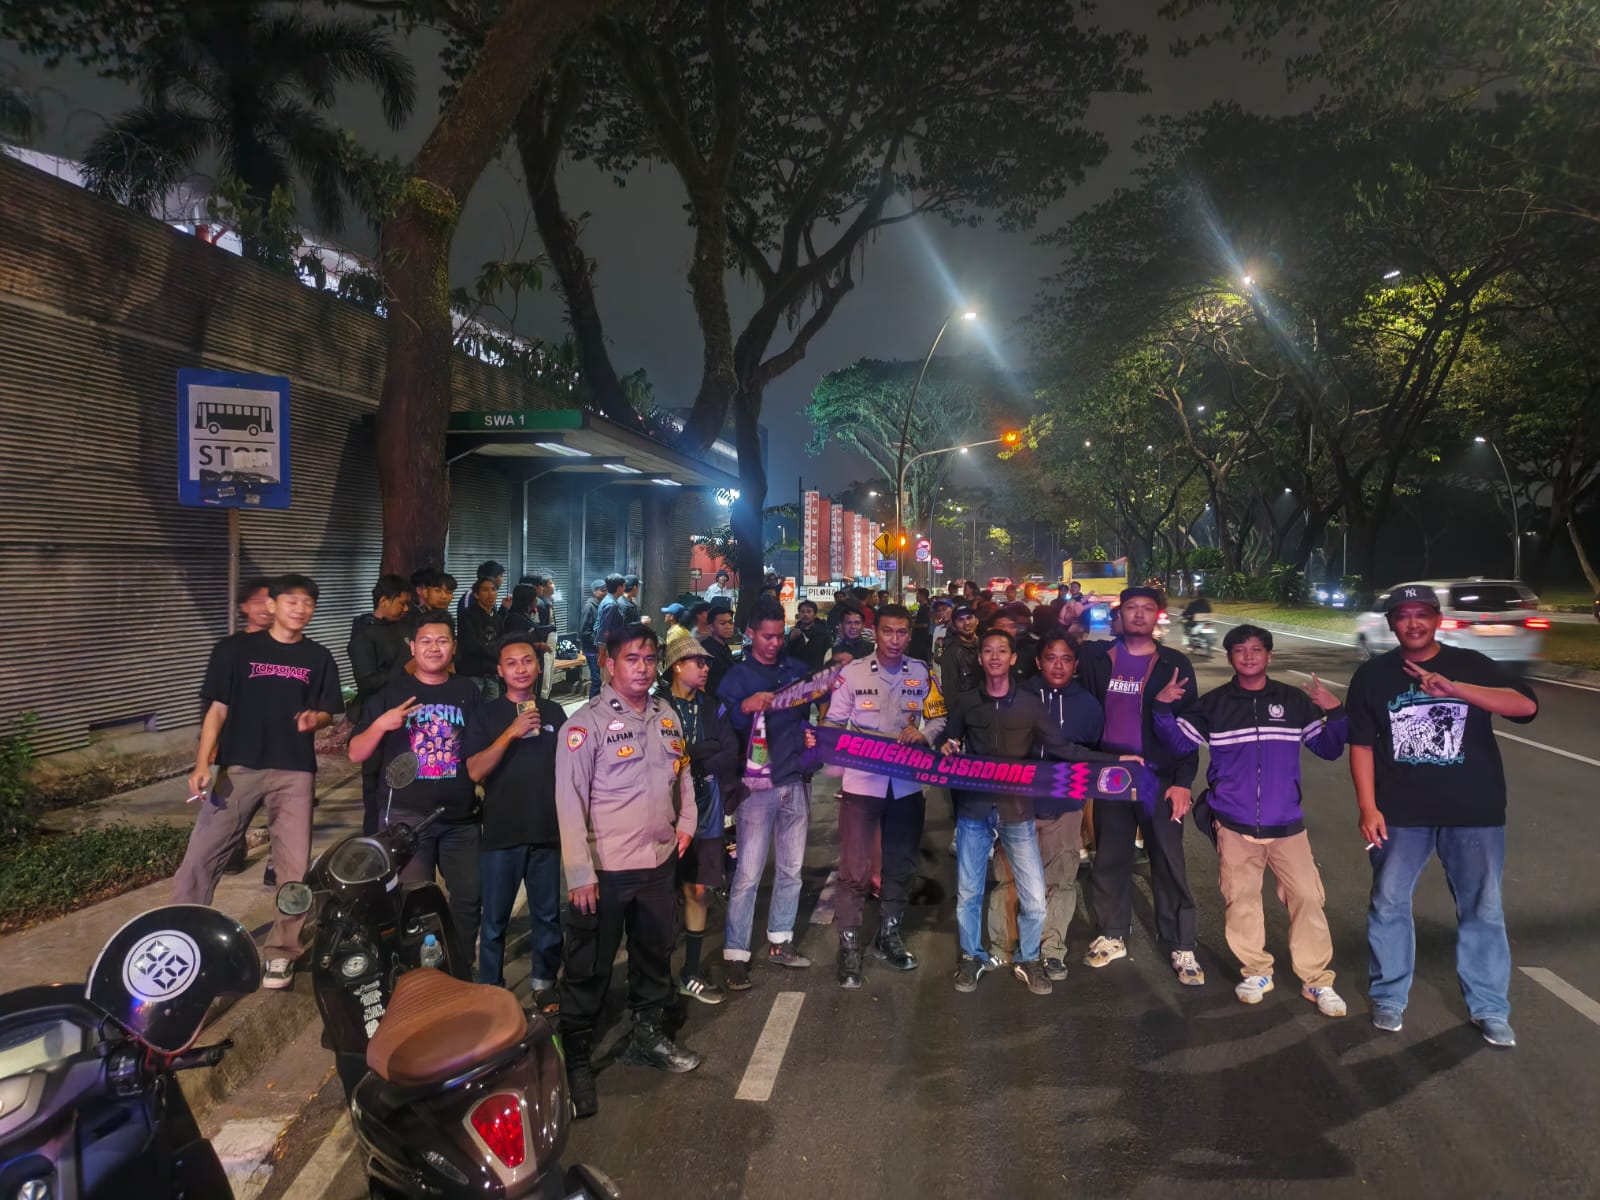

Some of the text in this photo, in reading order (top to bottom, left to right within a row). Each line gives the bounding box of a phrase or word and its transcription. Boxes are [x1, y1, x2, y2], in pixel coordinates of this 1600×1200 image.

[484, 414, 525, 426] SWA 1
[199, 445, 269, 466] ST
[1109, 680, 1140, 692] PERSITA
[606, 731, 634, 744] ALFIAN
[835, 734, 1038, 784] PENDEKAR CISADANE
